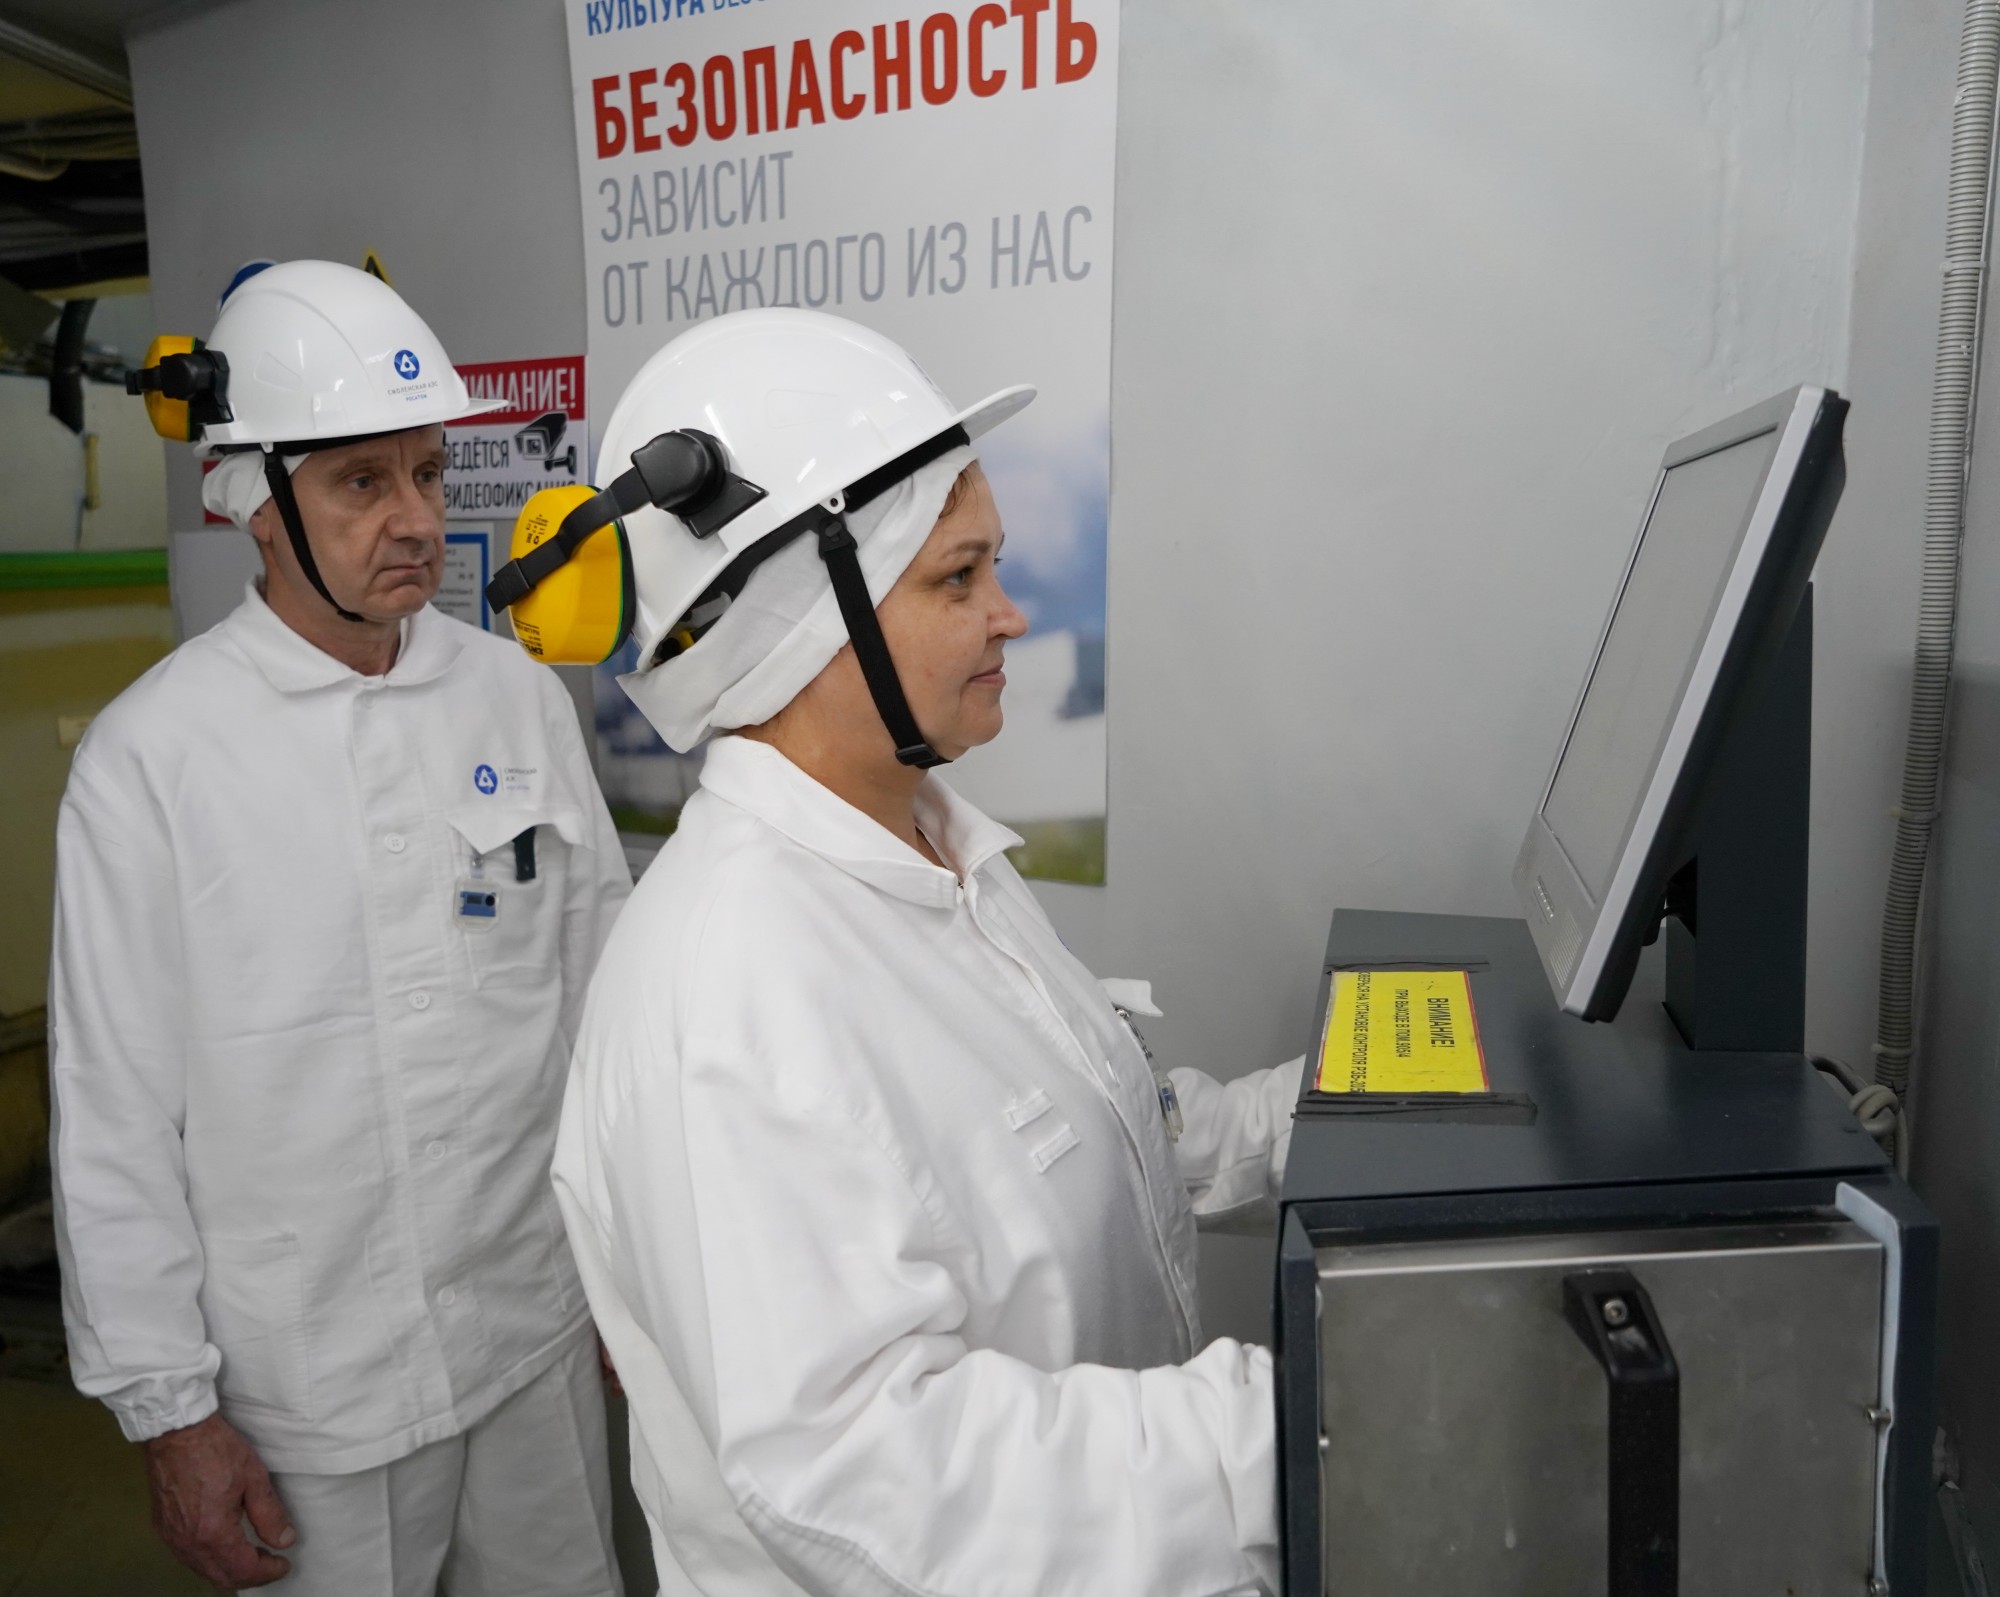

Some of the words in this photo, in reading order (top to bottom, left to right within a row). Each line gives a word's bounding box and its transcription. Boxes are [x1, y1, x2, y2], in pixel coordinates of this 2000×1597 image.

[592, 0, 1098, 159] БЕЗОПАСНОСТЬ
[598, 151, 794, 243] ЗАВИСИТ
[603, 260, 649, 328] ОТ
[666, 232, 886, 323] КАЖДОГО
[907, 222, 968, 298] ИЗ
[990, 205, 1093, 290] НАС
[444, 481, 576, 511] ВИДЕОФИКС
[1395, 988, 1409, 1000] ПРИ
[1353, 1002, 1370, 1032] УСТАНОВКЕ
[1393, 1001, 1409, 1023] ВЫХОДЕ
[1427, 997, 1455, 1048] ВНИМАНИЕ!
[1352, 1033, 1368, 1065] КОНТРОЛЯ
